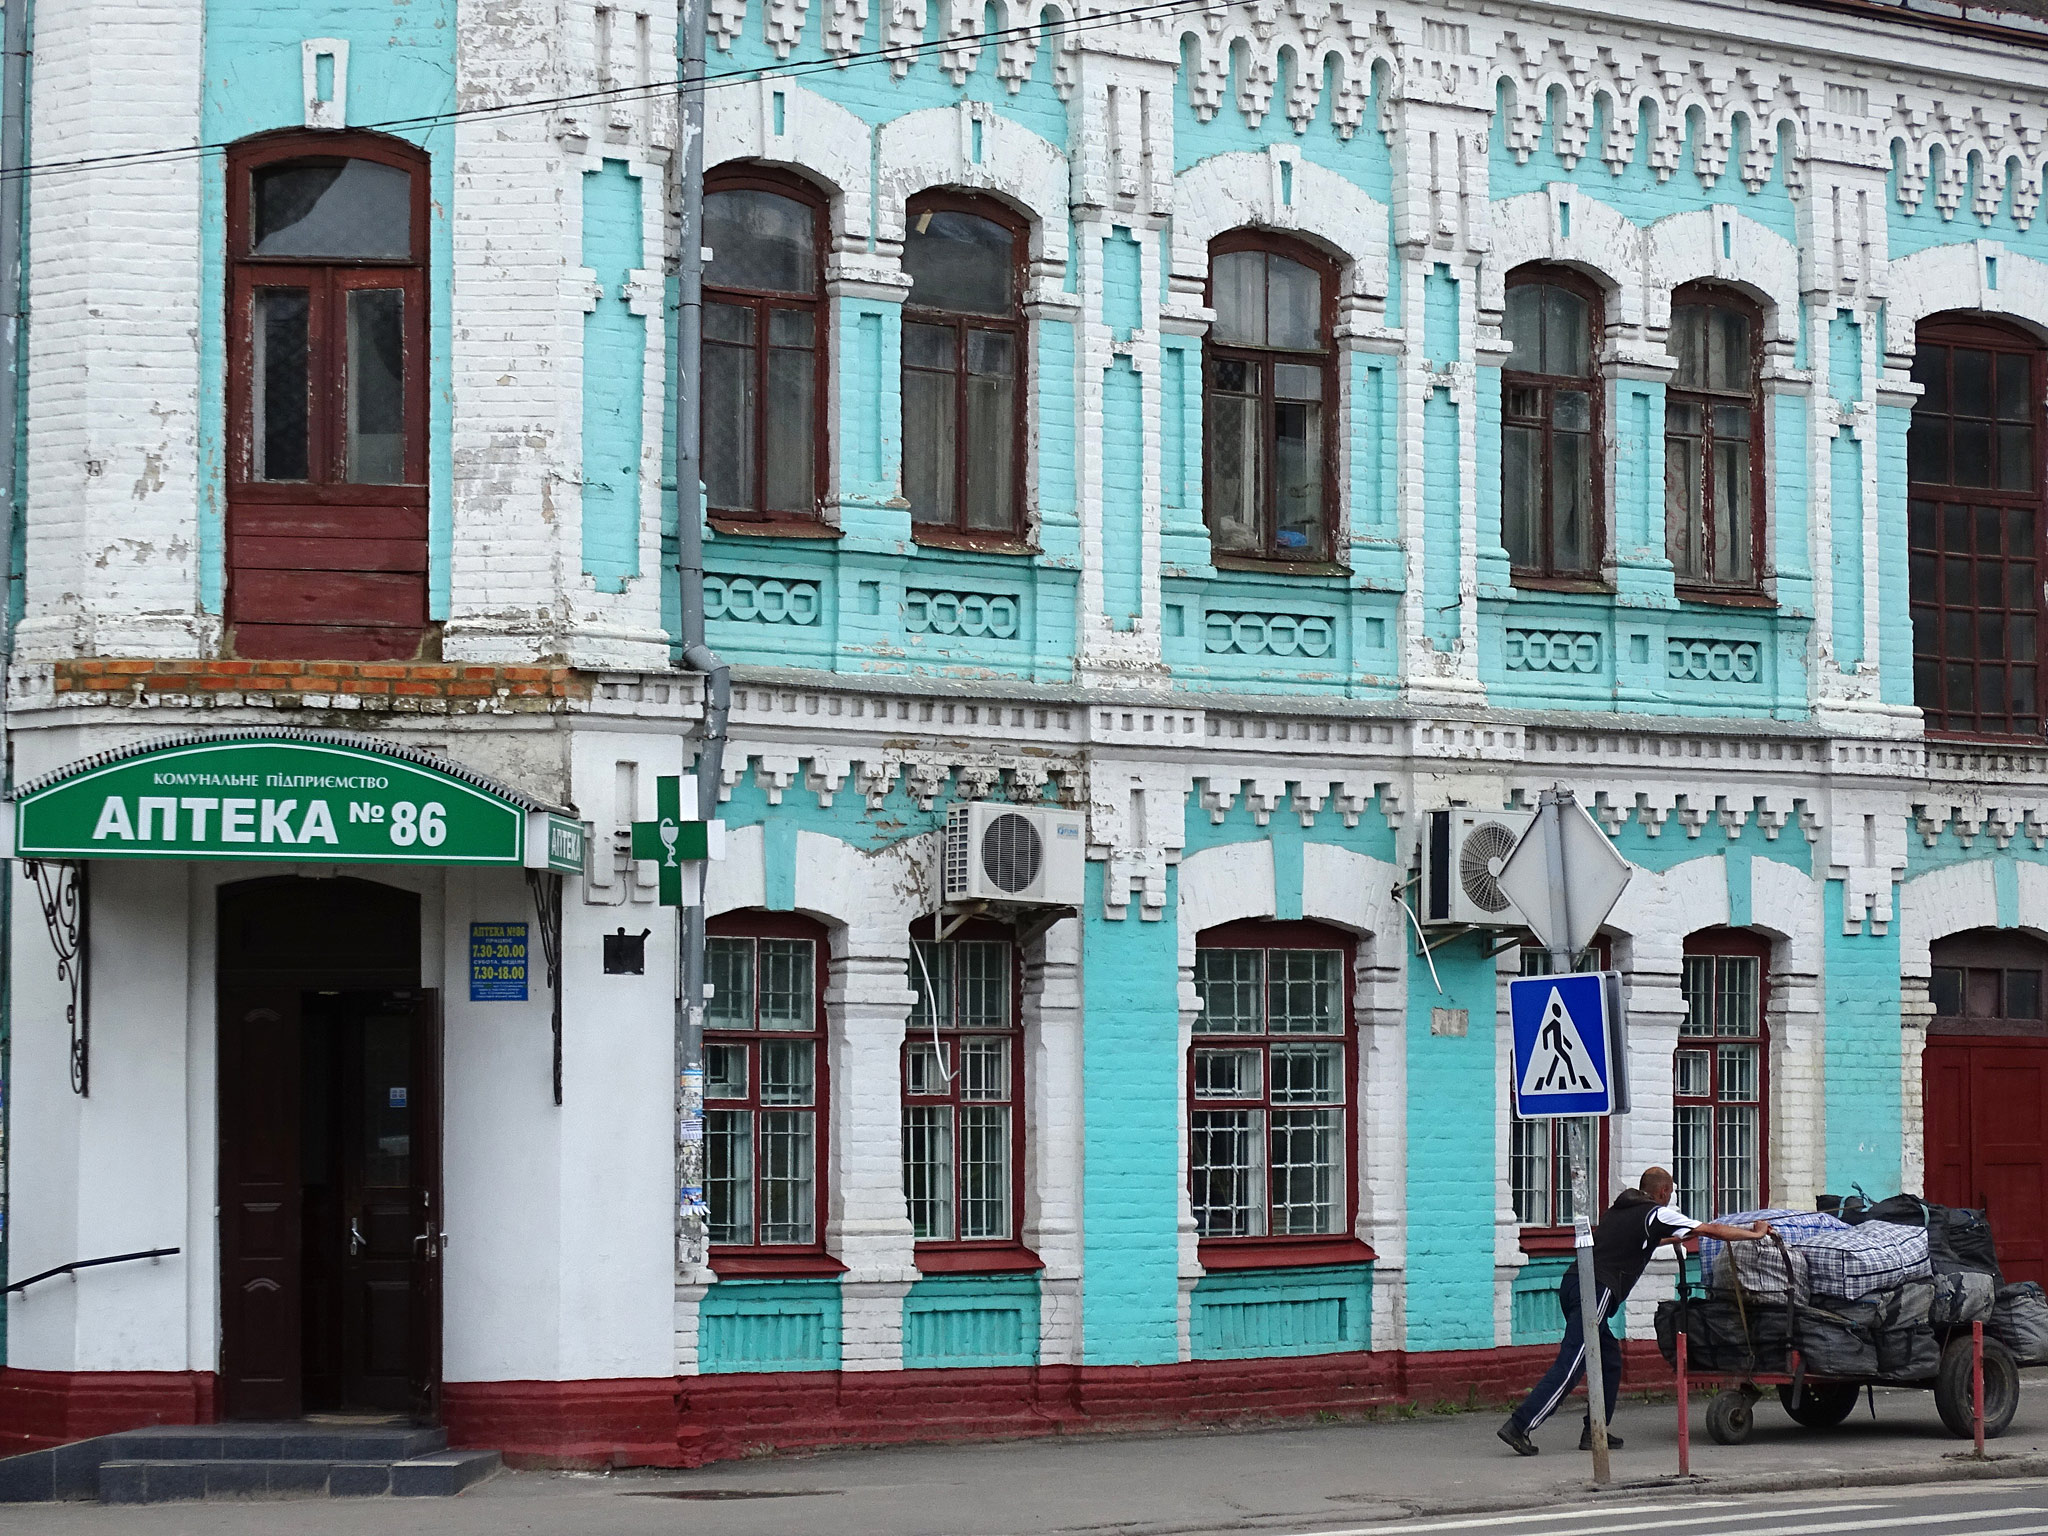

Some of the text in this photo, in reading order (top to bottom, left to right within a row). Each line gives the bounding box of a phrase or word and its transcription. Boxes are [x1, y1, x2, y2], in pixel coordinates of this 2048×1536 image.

[153, 772, 259, 787] КОМУНАЛЬНЕ
[92, 796, 340, 844] АПТЕКА
[551, 827, 582, 862] АПТЕКА
[473, 927, 505, 936] АПТЕКА
[473, 945, 525, 957] 7.30-20.00
[474, 967, 524, 979] 7.30-18.00
